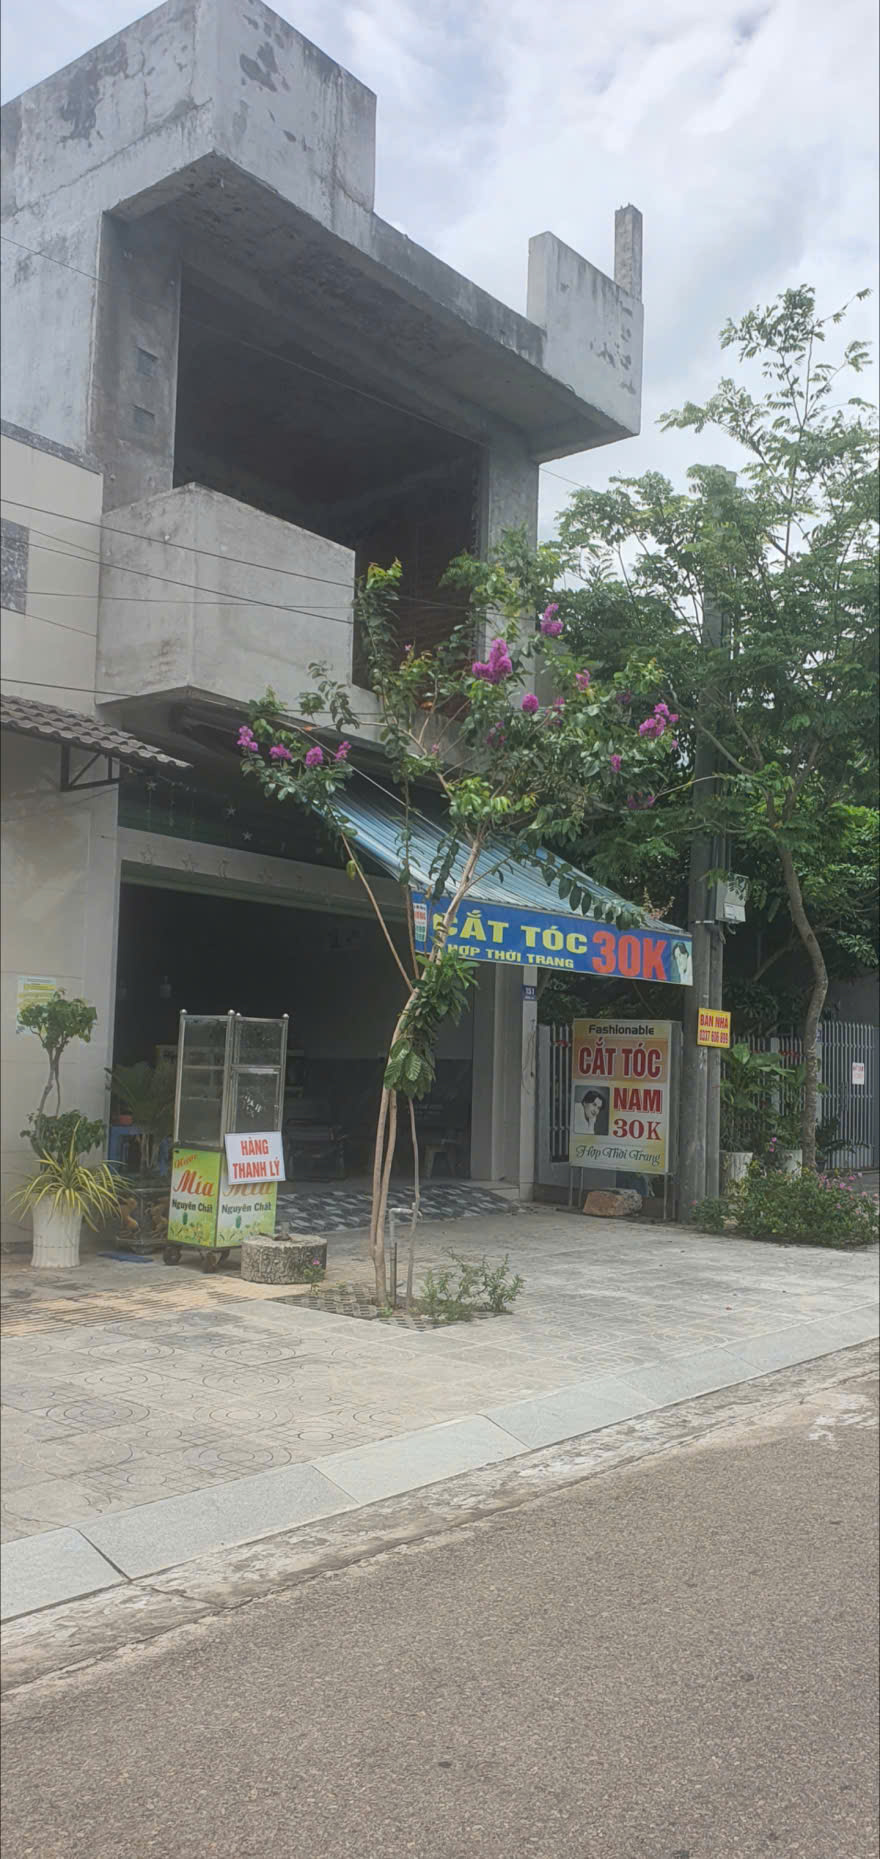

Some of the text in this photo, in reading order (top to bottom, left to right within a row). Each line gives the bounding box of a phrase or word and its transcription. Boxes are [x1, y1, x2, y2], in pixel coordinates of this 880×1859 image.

[432, 909, 509, 944] CẮT
[520, 925, 588, 954] TÓC
[591, 930, 667, 981] 30K
[447, 943, 575, 969] HỢP THỜI TRANG
[588, 1024, 655, 1036] Fashionable
[579, 1037, 661, 1078] CẮT TÓC
[613, 1087, 662, 1113] NAM
[240, 1136, 269, 1156] HÀNG
[575, 1144, 661, 1167] Hợp Thời Trang
[232, 1156, 280, 1179] THANH LÝ
[173, 1169, 216, 1197] Mía
[172, 1199, 213, 1213] Nguyên Chất
[221, 1202, 272, 1215] Nguyên Chất
